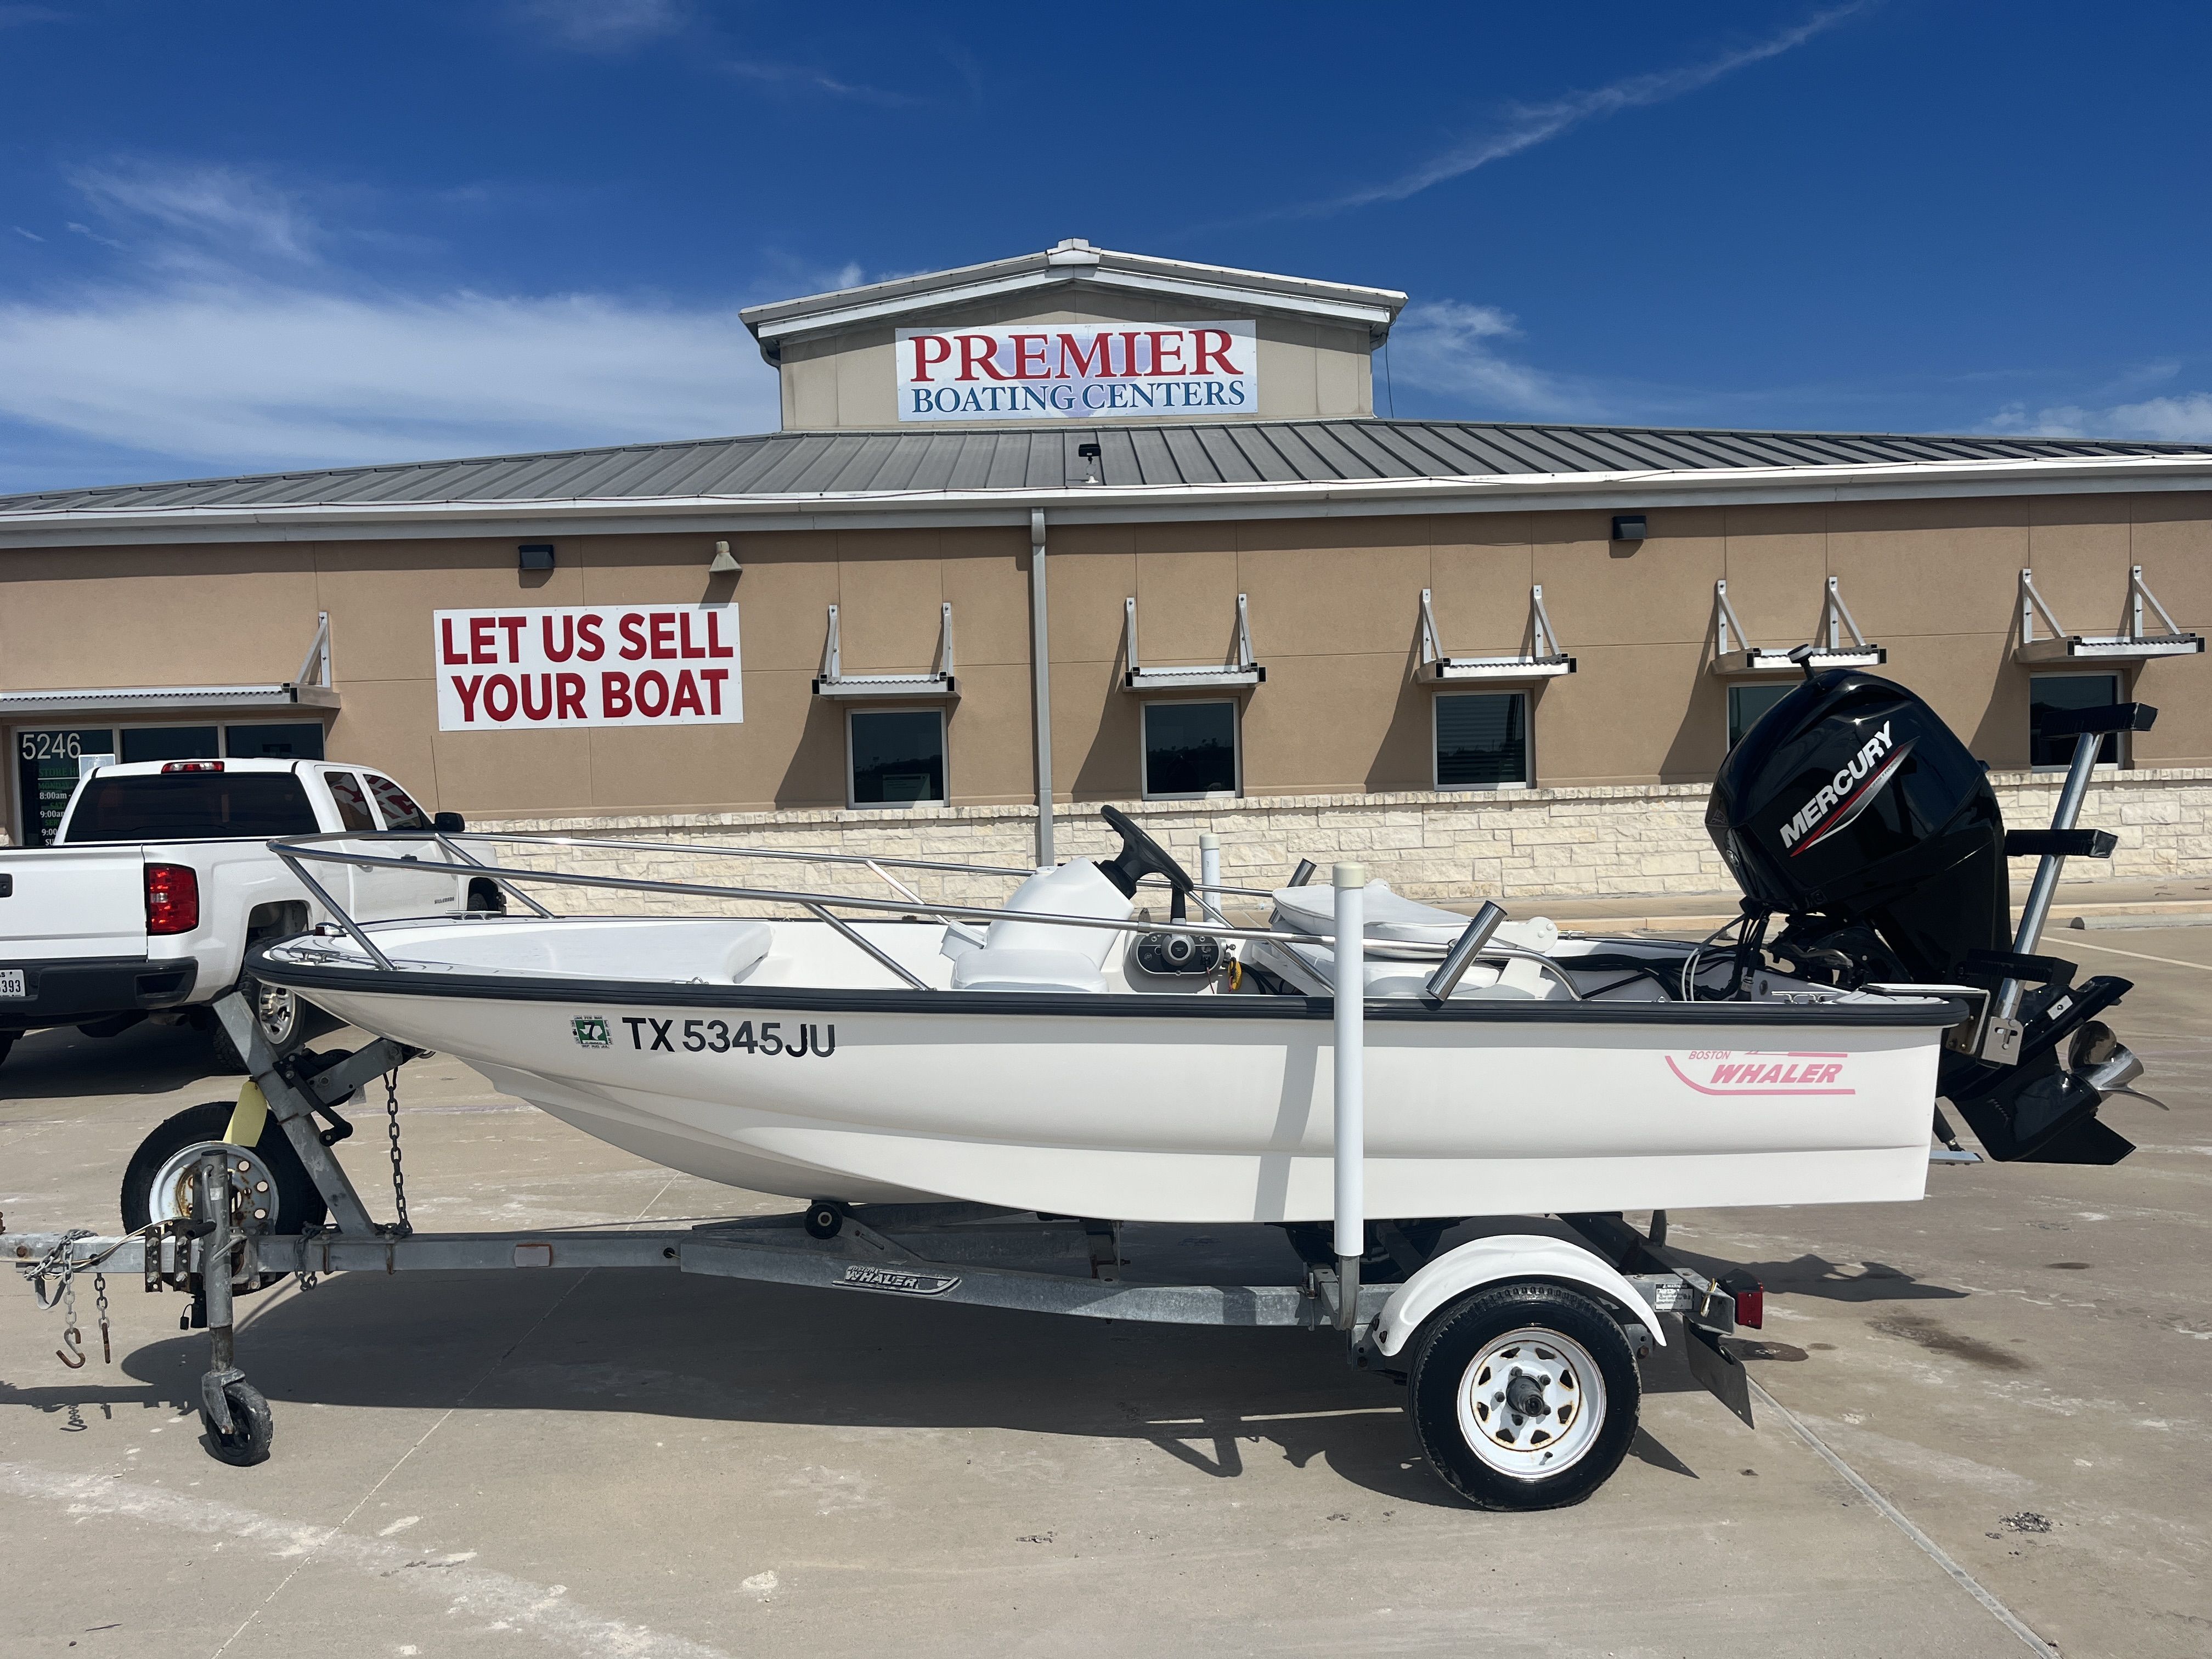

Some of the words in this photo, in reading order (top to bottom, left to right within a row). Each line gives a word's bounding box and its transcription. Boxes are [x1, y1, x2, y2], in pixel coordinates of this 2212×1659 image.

[909, 329, 1244, 382] PREMIER
[911, 385, 1076, 413] BOATING
[1082, 381, 1245, 409] CENTERS
[442, 616, 527, 664] LET
[542, 614, 605, 662] US
[618, 612, 733, 661] SELL
[450, 673, 588, 722] YOUR
[601, 669, 729, 718] BOAT
[22, 733, 81, 760] 5246
[40, 792, 67, 800] 8:00am
[1779, 720, 1893, 849] MERCURY
[0, 980, 21, 992] 393
[622, 1017, 675, 1052] TX
[1689, 1051, 1731, 1060] BOSTON
[1710, 1064, 1843, 1084] WHALER
[845, 1270, 919, 1289] WHALER
